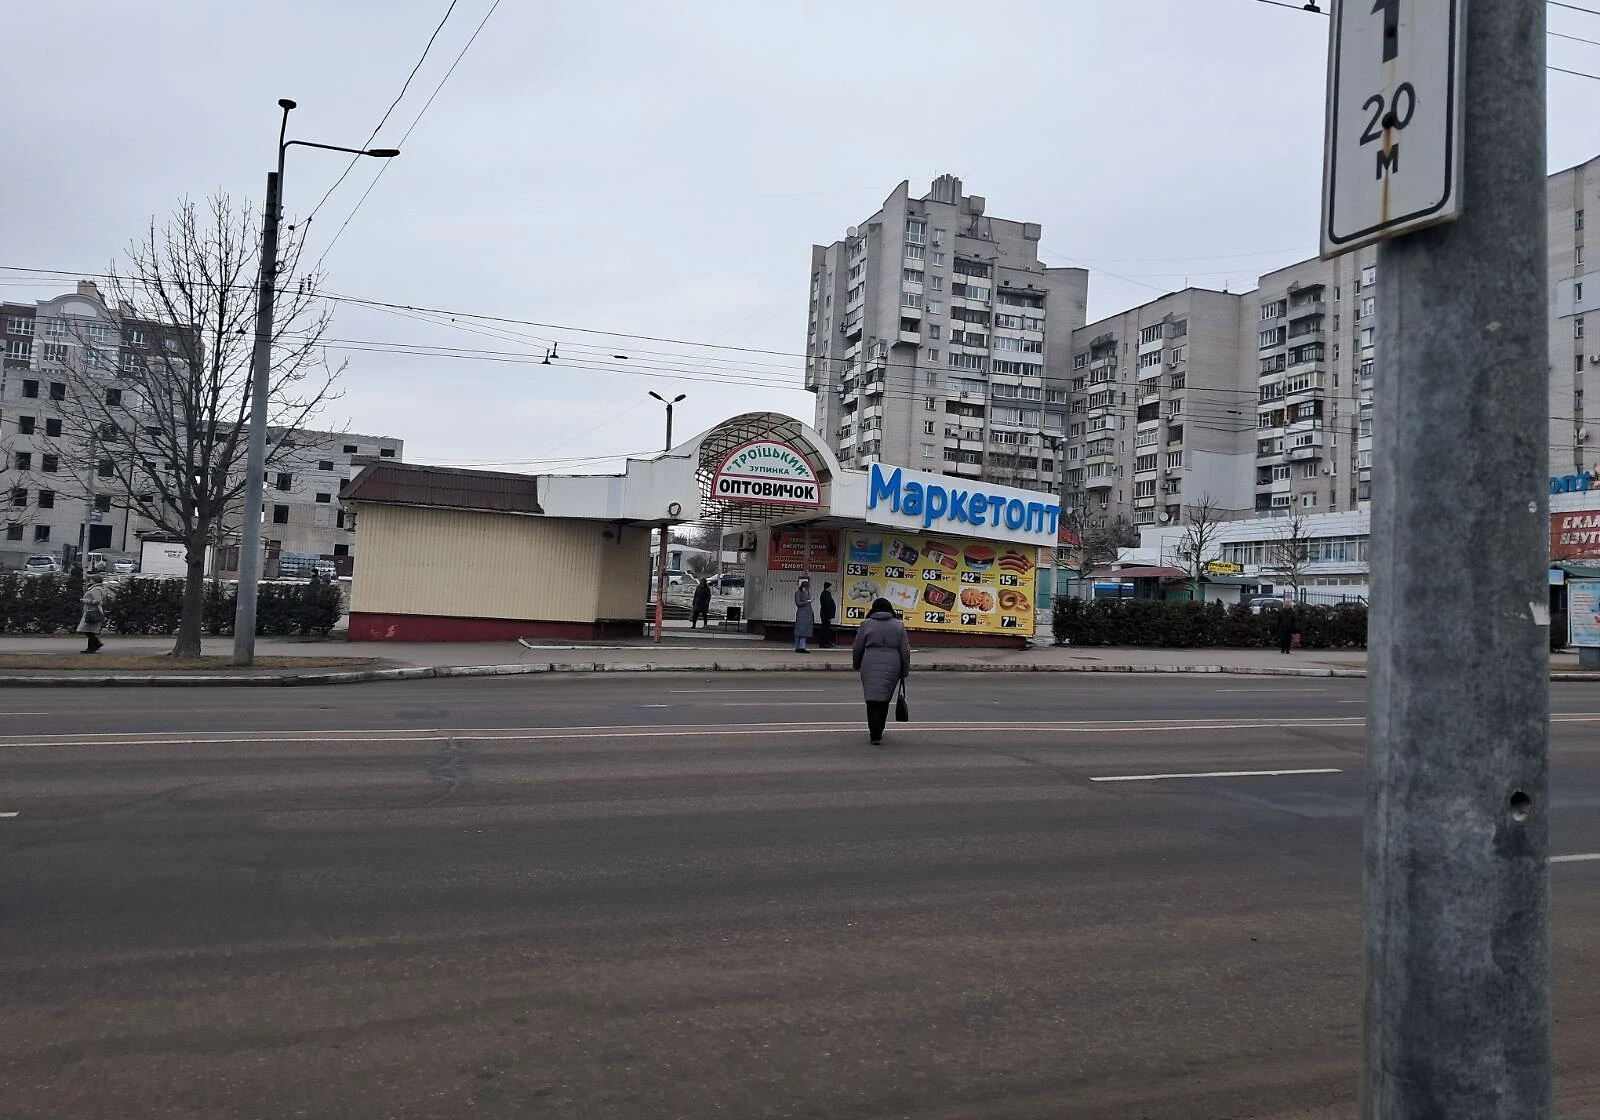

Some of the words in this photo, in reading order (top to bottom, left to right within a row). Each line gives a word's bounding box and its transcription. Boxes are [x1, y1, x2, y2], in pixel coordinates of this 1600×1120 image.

[1360, 82, 1416, 146] 20
[719, 478, 815, 500] ОПТОВИЧОК
[749, 465, 790, 475] ЗУПИНКА
[868, 463, 1061, 534] Маркетопт
